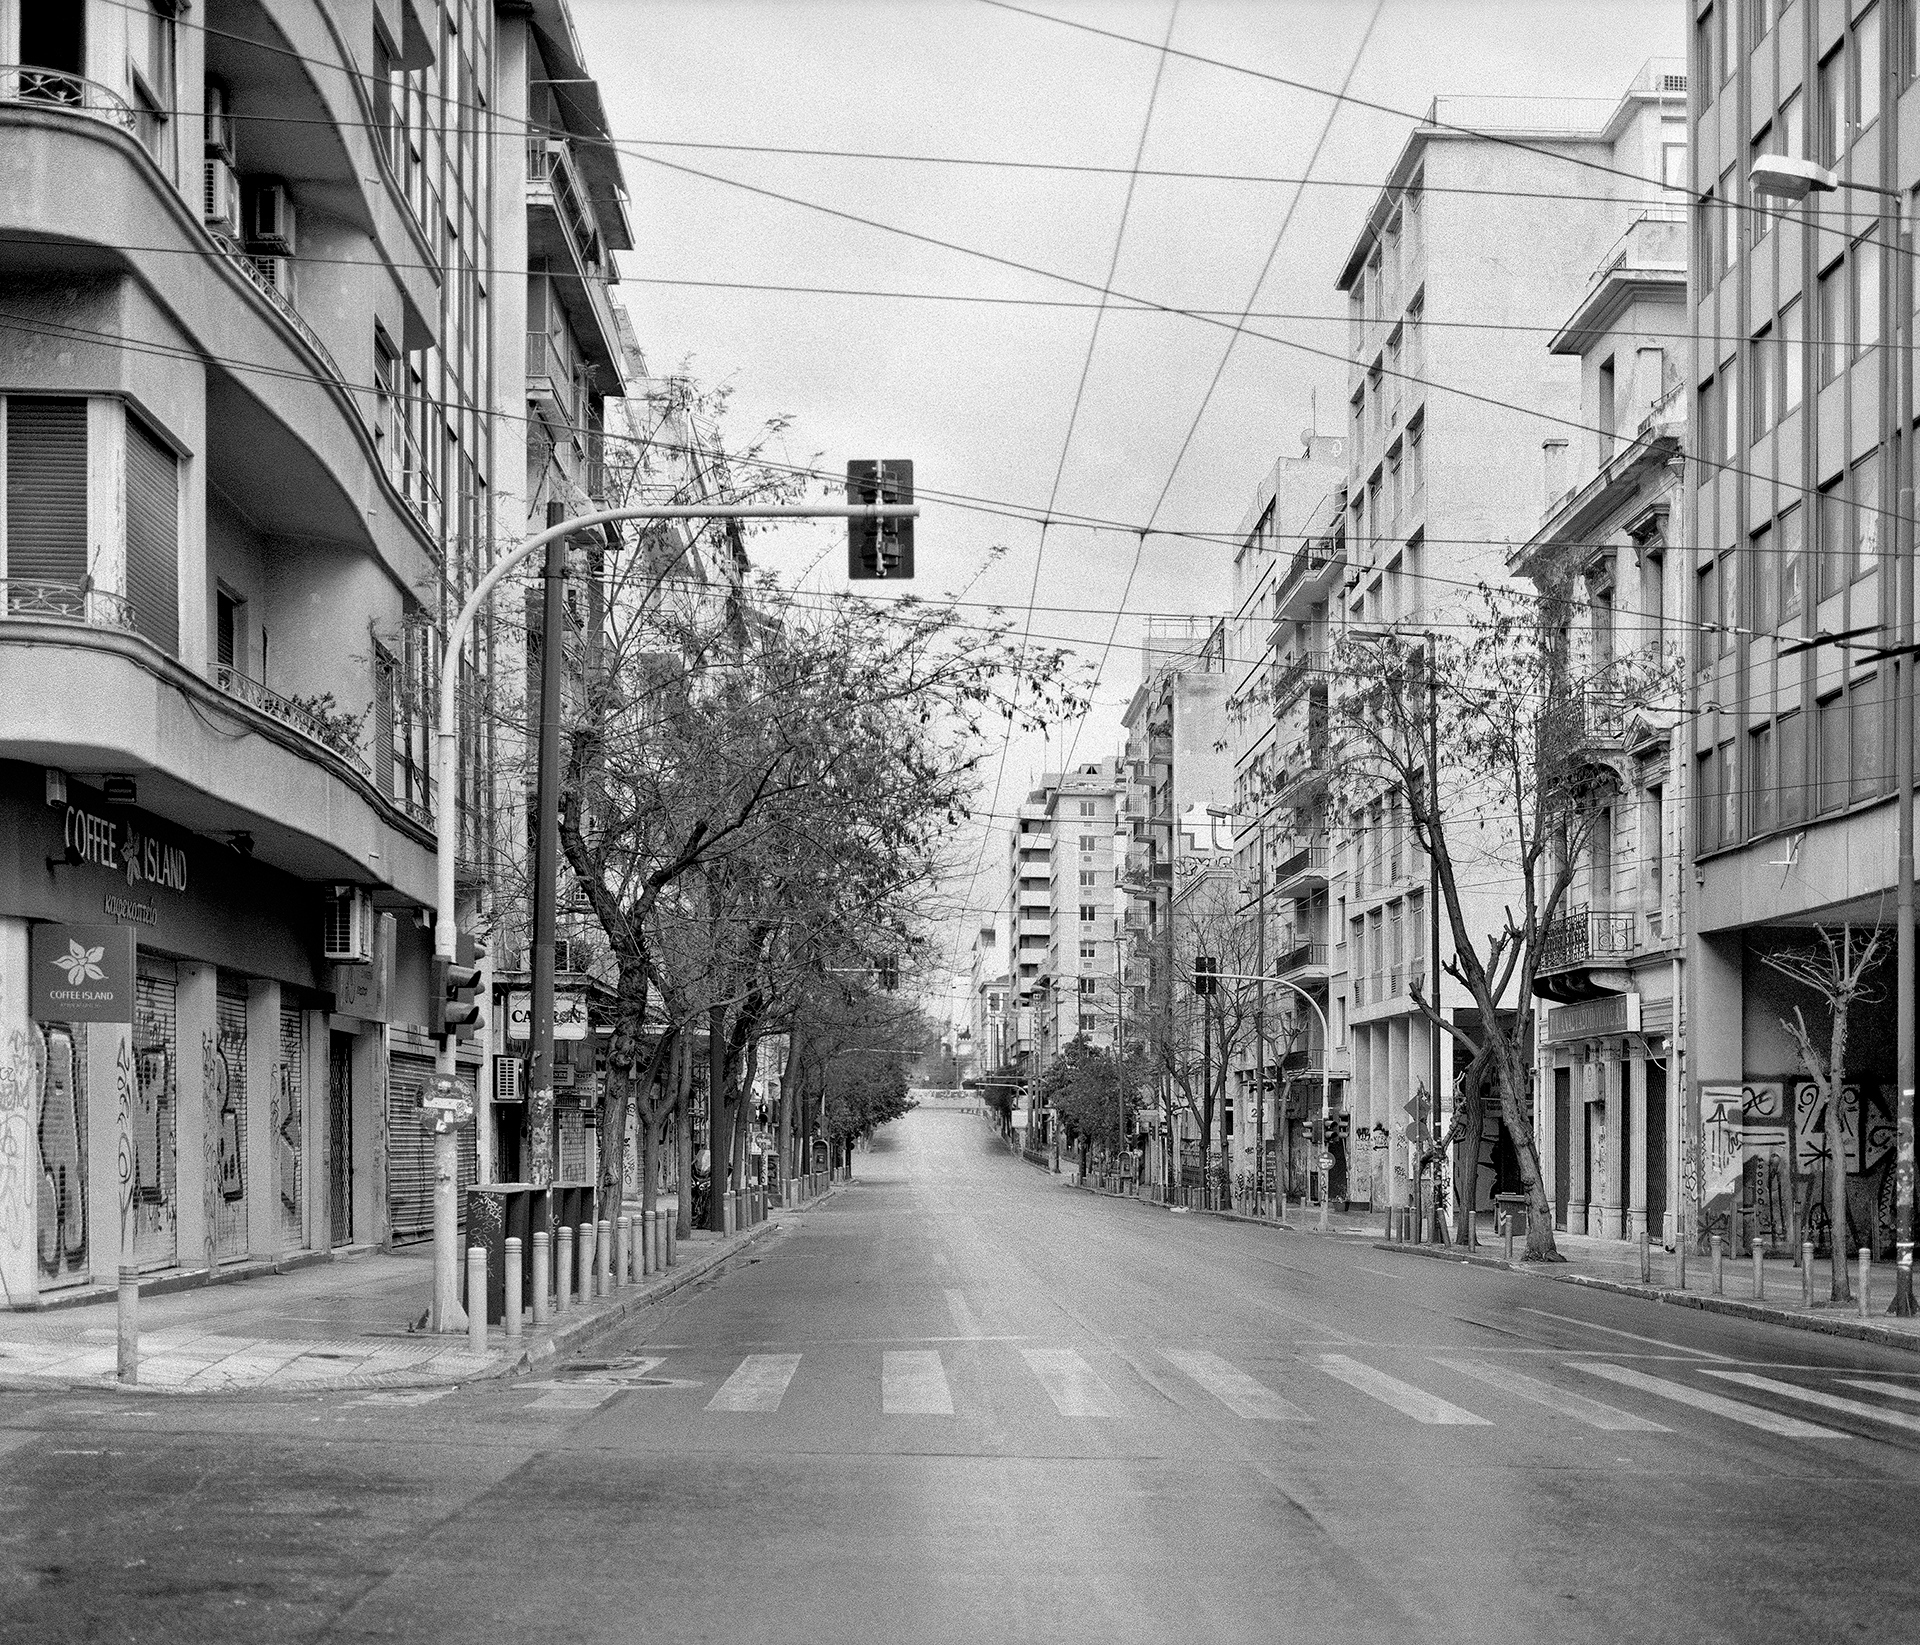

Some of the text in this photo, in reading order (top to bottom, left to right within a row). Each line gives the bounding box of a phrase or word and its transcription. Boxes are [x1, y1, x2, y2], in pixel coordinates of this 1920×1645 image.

[65, 805, 187, 892] COFFEE ISLAND
[49, 990, 114, 1001] COFFEE ISLAND
